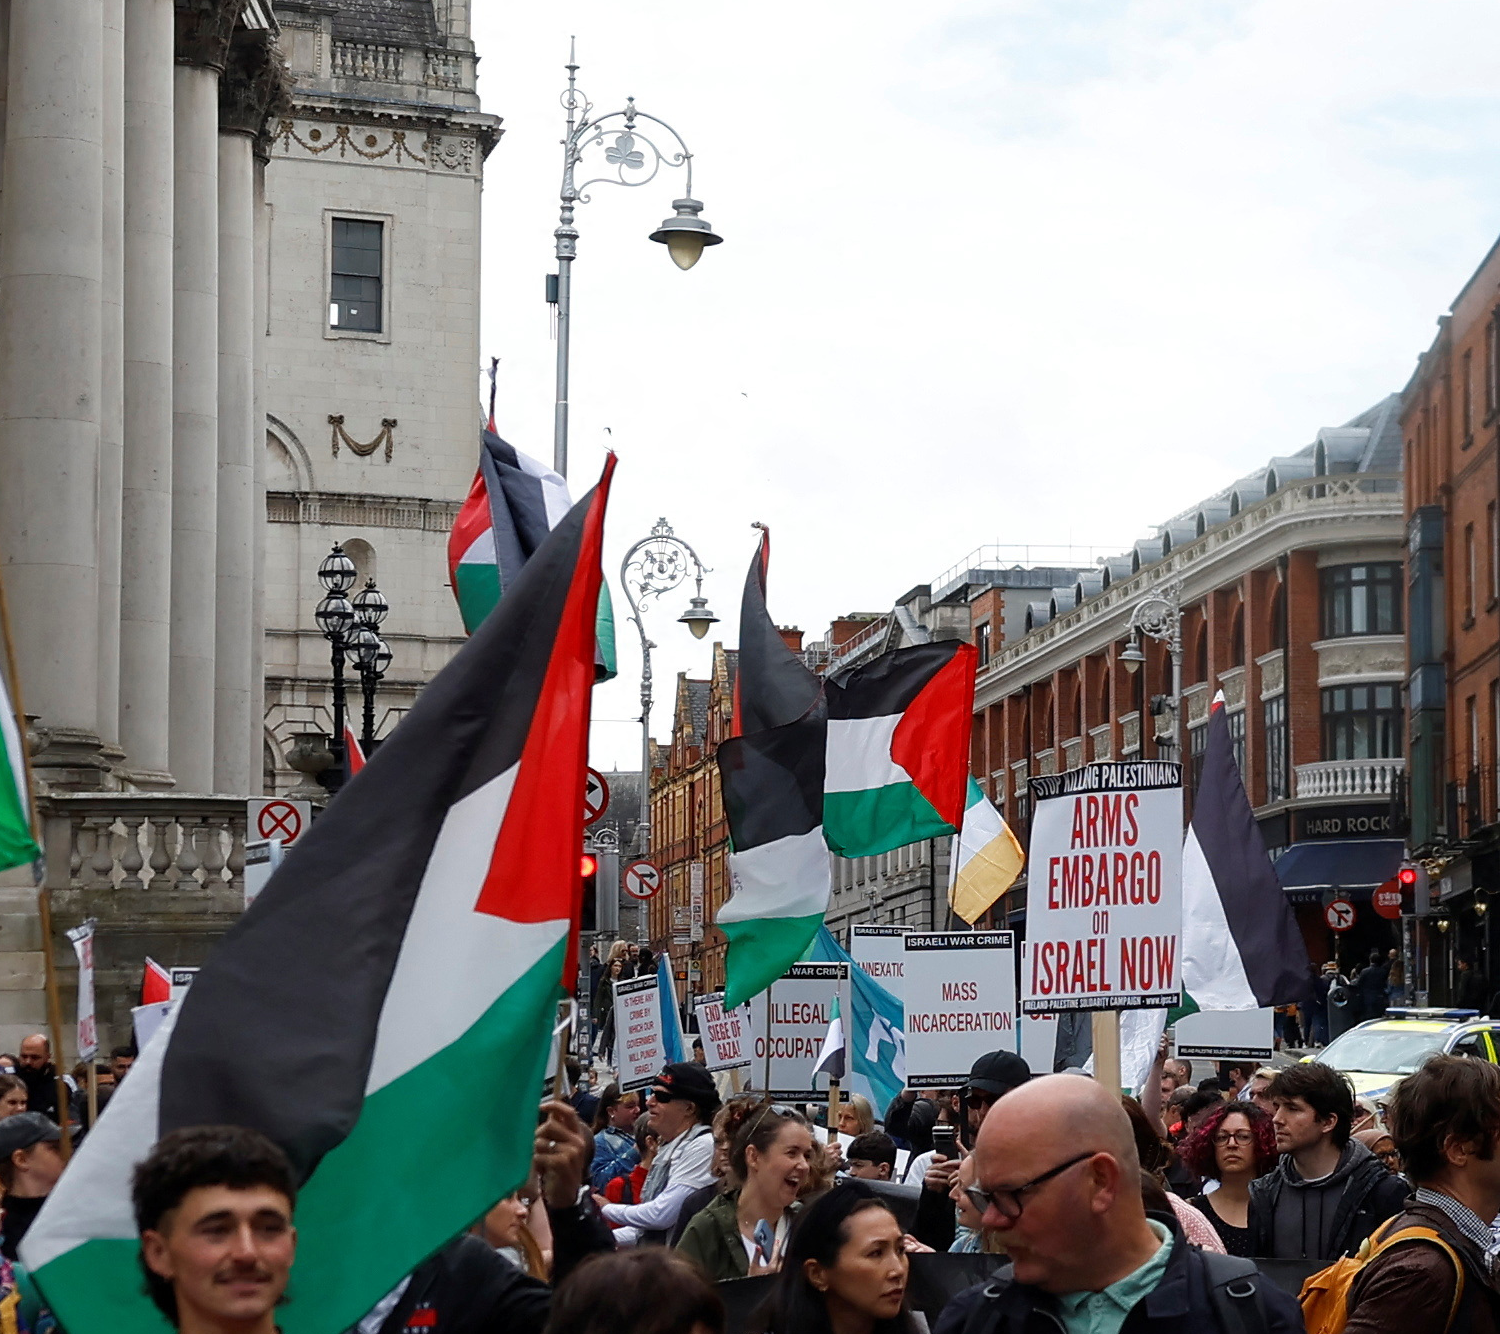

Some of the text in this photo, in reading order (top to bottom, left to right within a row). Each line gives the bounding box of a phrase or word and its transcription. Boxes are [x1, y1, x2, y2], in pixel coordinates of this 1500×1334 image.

[1032, 777, 1062, 797] STOP
[1102, 762, 1180, 788] PALESTINIANS
[1070, 793, 1140, 850] ARMS
[1306, 816, 1391, 835] HARD ROCK
[1048, 850, 1162, 910] EMBARGO
[1092, 910, 1109, 936] on
[907, 935, 1010, 947] ISRAELI WAR CRIME
[791, 967, 814, 976] WAR
[816, 967, 846, 977] CRIME
[858, 961, 904, 977] NNEXATI
[1031, 934, 1177, 997] ISRAEL NOW
[941, 982, 978, 1002] MASS
[1109, 996, 1141, 1008] CAMPAIGN
[704, 1003, 722, 1023] END
[771, 1002, 830, 1025] ILLEGAL
[909, 1011, 1012, 1034] INCARCERATION
[707, 1019, 742, 1043] SIEGE OF
[716, 1040, 743, 1062] GAZA!
[755, 1037, 827, 1059] OCCUPAT
